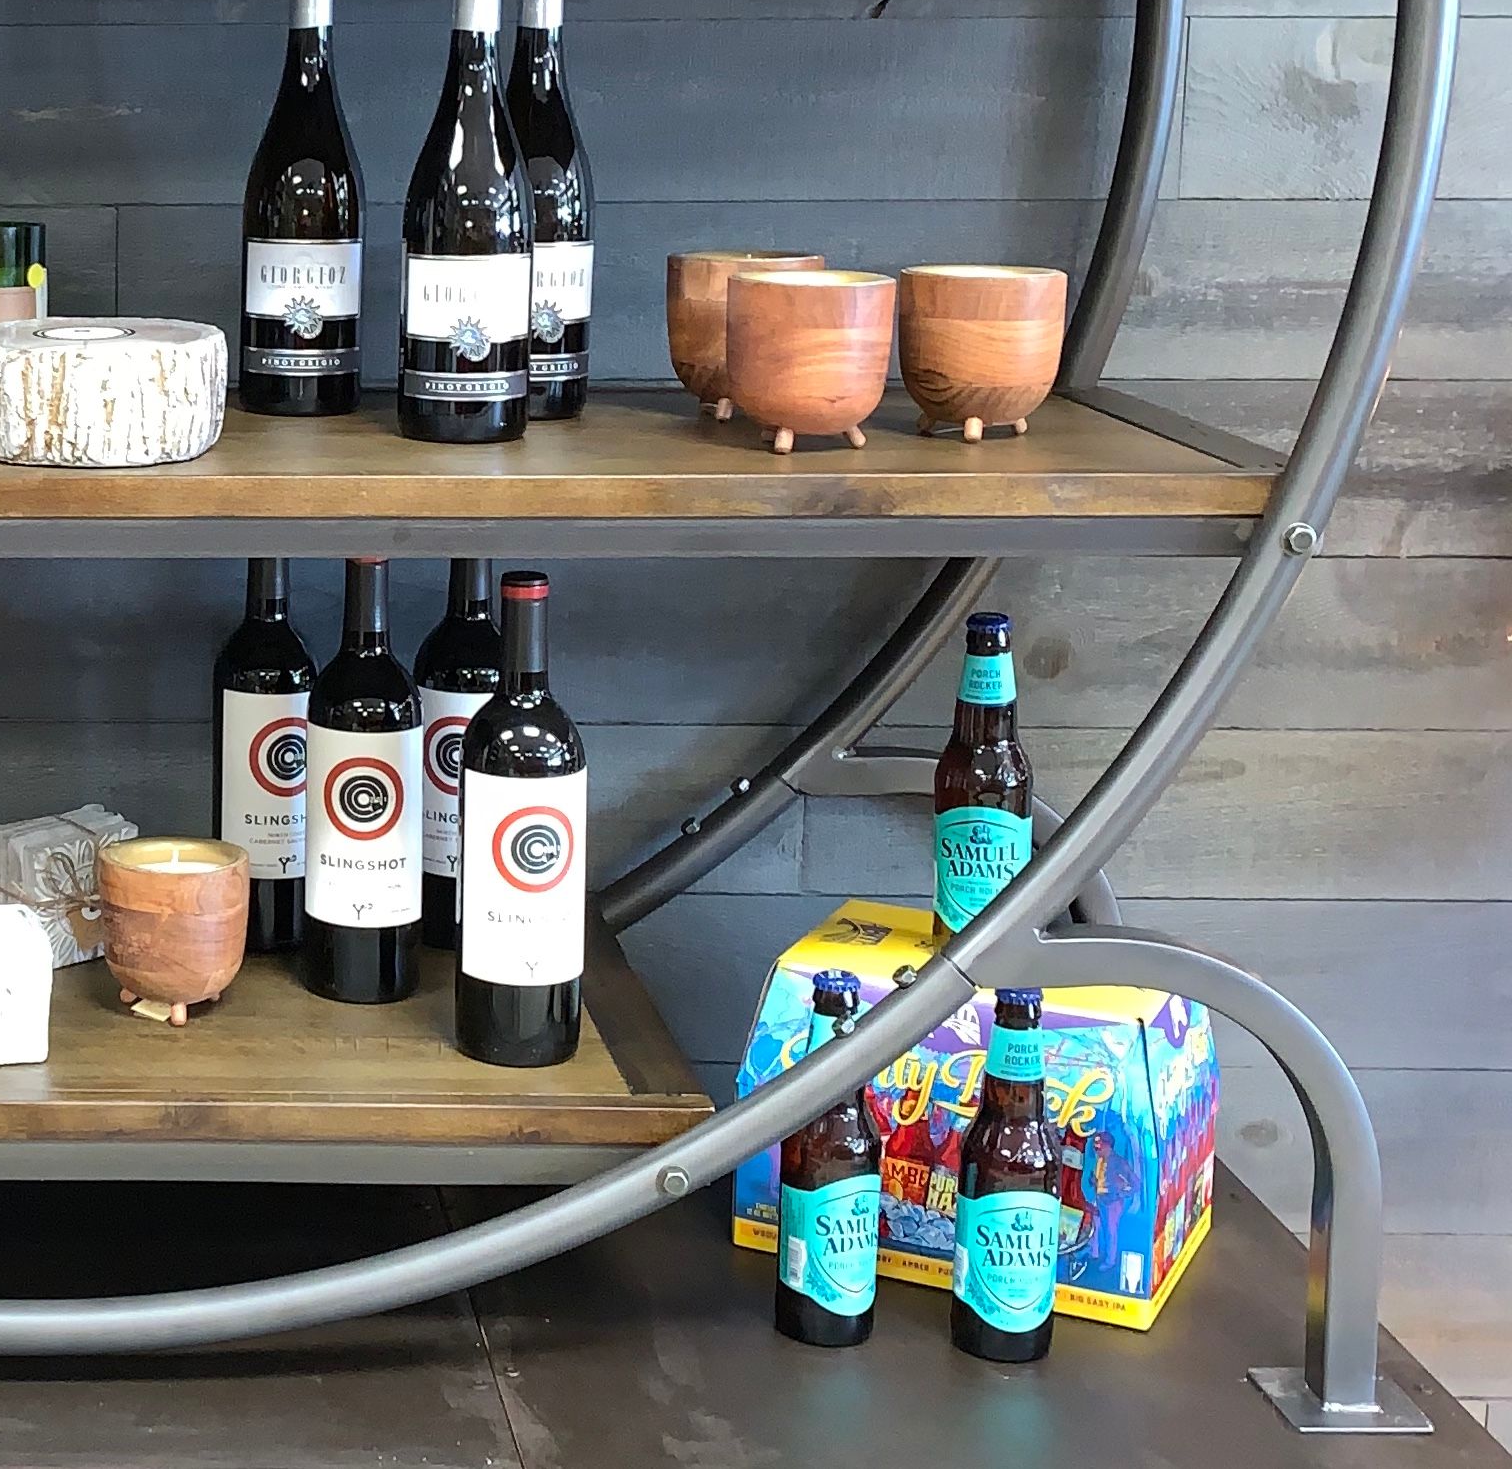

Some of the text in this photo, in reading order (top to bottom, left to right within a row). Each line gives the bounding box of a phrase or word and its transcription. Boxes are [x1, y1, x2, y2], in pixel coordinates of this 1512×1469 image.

[260, 264, 346, 286] GIORGIOZ
[535, 268, 585, 288] RGIOZ
[261, 357, 341, 366] PINOT GRIGIO
[541, 361, 579, 371] GRIGIO
[425, 382, 510, 391] PINOT GRIGIO
[971, 668, 1001, 679] PORCH
[968, 680, 1003, 690] ROCKER
[244, 813, 306, 826] SLINGSH
[941, 838, 1020, 862] SAMUEL
[319, 853, 407, 871] SLINGSHOT
[946, 860, 1014, 880] ADAMS
[1008, 1042, 1039, 1054] PORCH
[1005, 1055, 1041, 1066] ROCKER
[981, 1247, 1051, 1268] ADAMS
[1069, 1293, 1126, 1312] BIG EASY IPA
